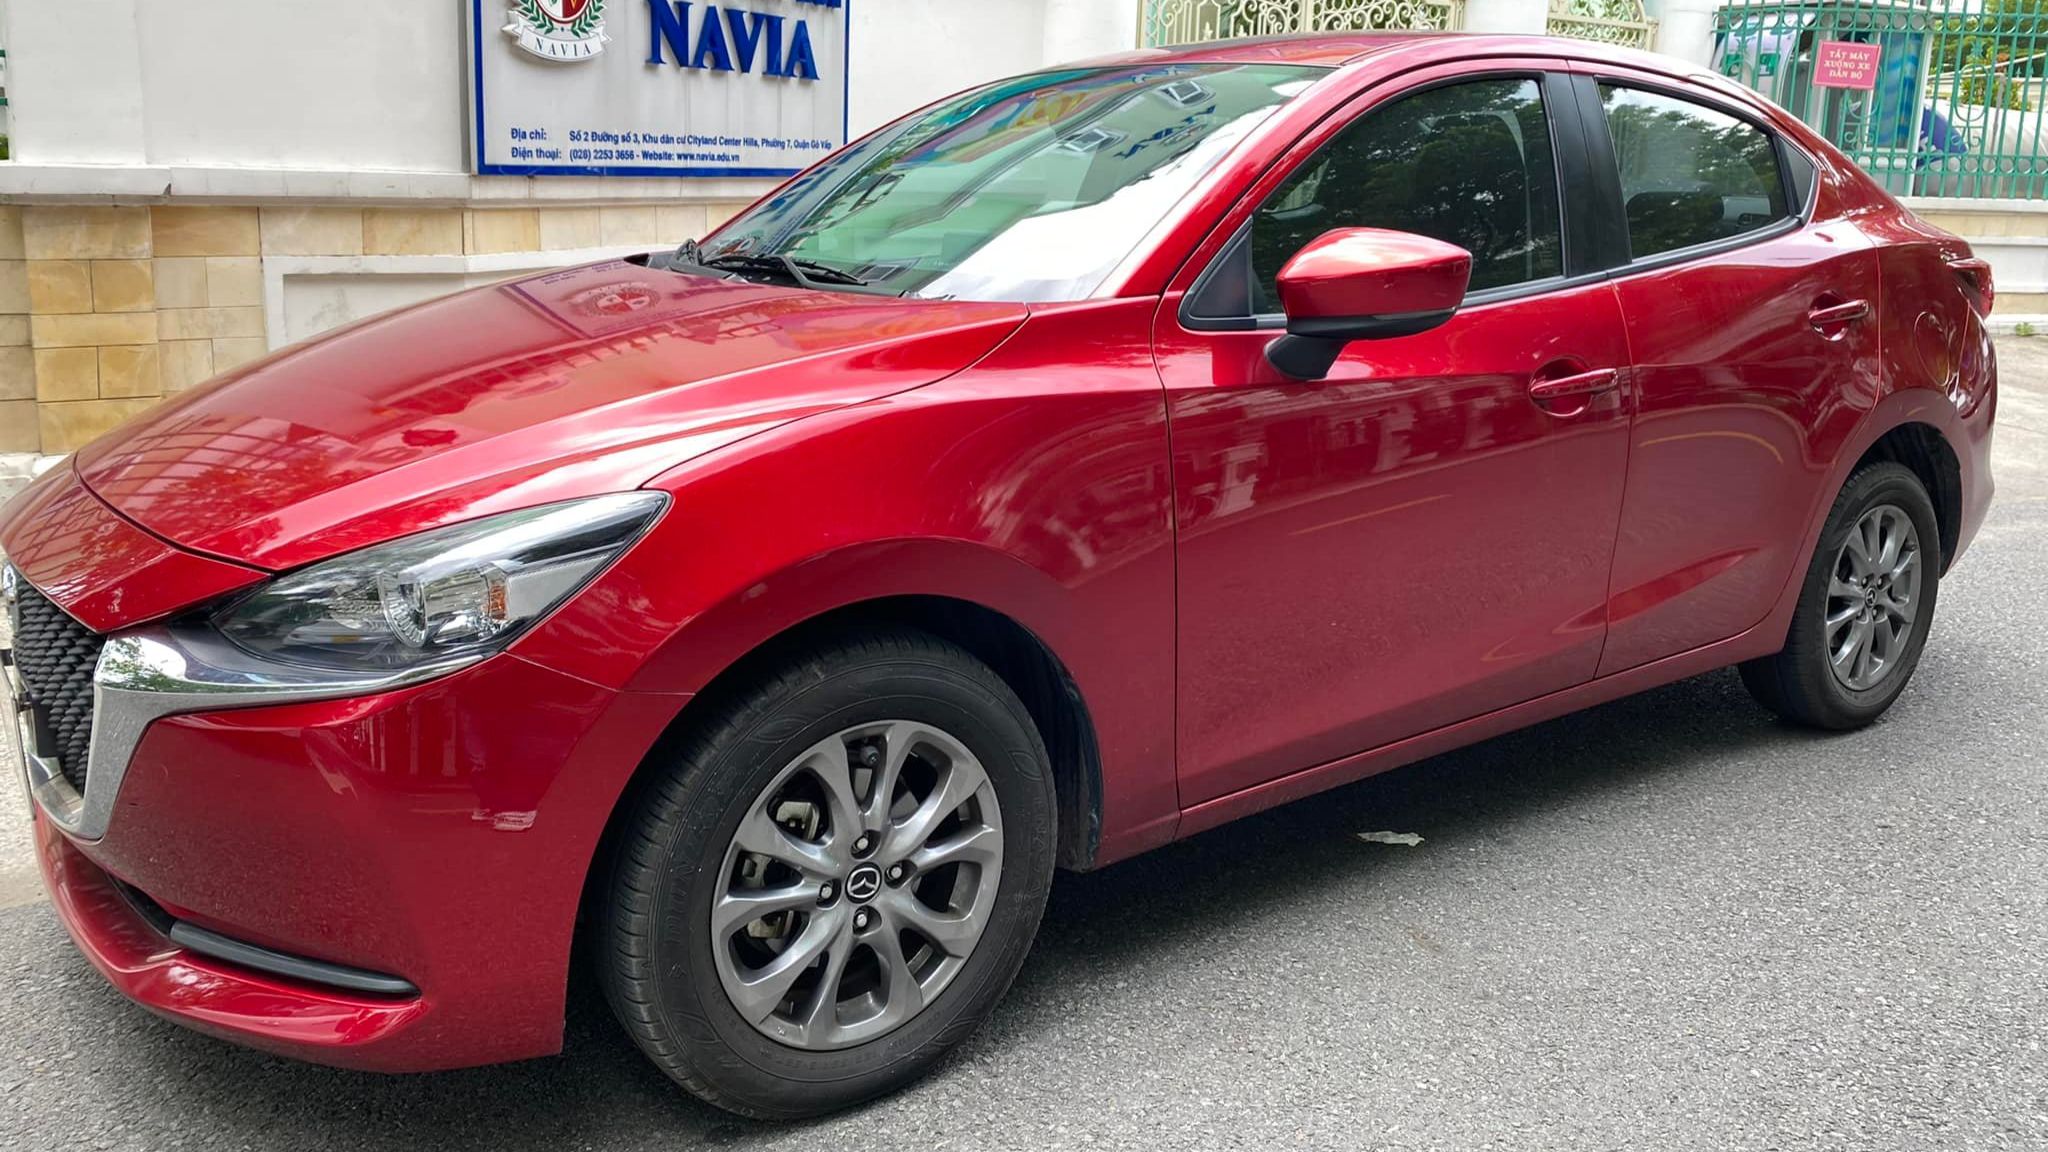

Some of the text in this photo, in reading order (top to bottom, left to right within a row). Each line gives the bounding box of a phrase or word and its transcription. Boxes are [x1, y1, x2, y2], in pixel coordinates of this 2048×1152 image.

[535, 37, 592, 57] NAVIA
[645, 0, 821, 81] NAVIA
[511, 128, 527, 142] Địa
[529, 127, 547, 140] chỉ:
[569, 129, 582, 142] Số
[584, 131, 589, 142] 2
[591, 131, 619, 145] Đường
[621, 130, 632, 143] số
[633, 132, 640, 145] 3,
[642, 133, 659, 144] Khu
[660, 133, 675, 145] dân
[687, 134, 718, 147] Cityland
[718, 136, 741, 146] Center
[511, 147, 533, 160] Điện
[536, 147, 562, 161] thoại:
[569, 148, 592, 162] (028)
[593, 149, 614, 160] 2253
[641, 150, 675, 161] Website:
[676, 151, 740, 163] www.navia.edu.vn
